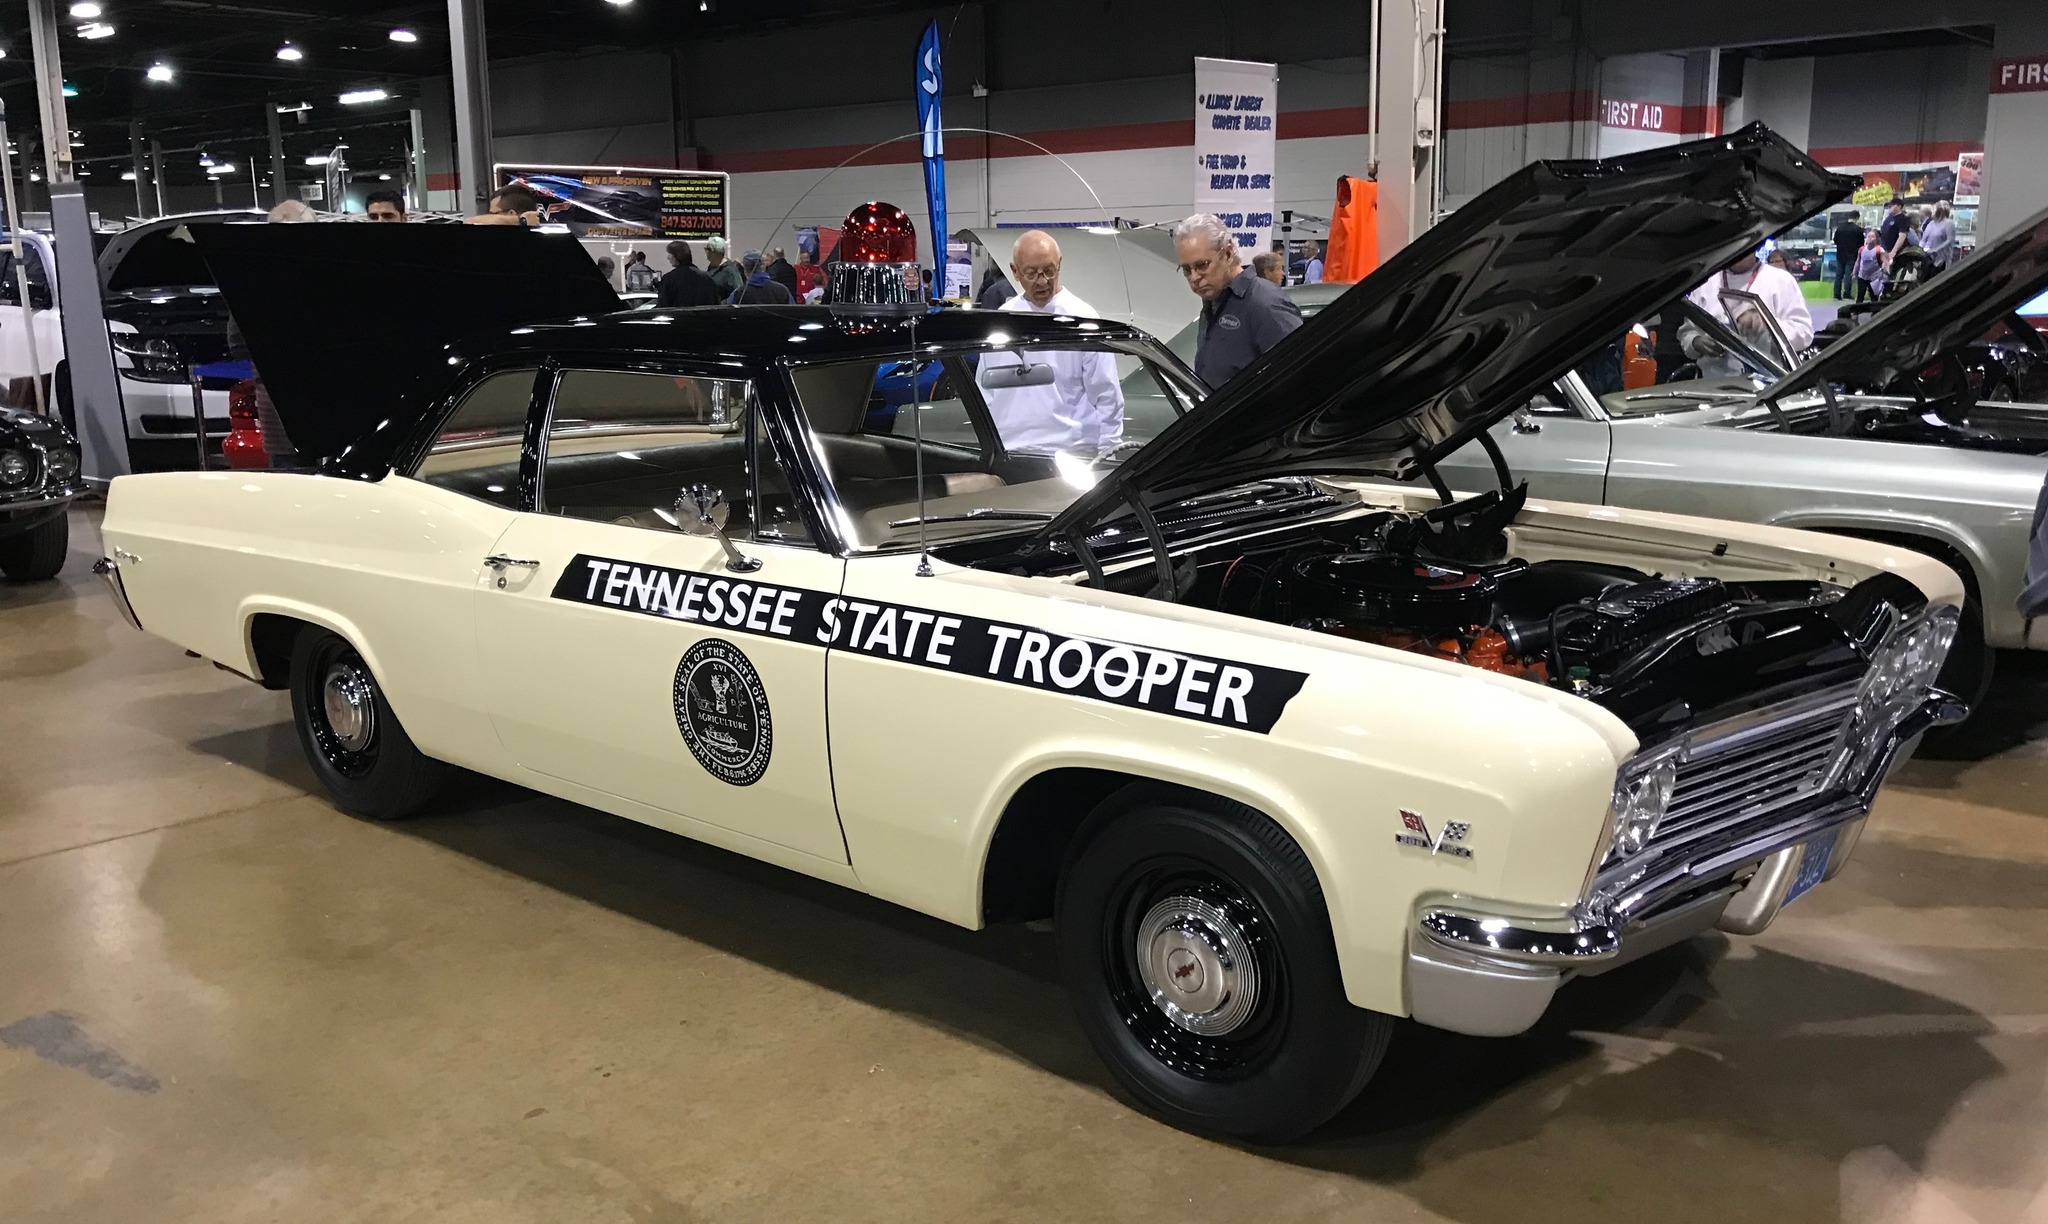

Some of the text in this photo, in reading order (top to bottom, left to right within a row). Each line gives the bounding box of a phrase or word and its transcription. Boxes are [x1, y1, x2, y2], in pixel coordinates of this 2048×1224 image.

[1244, 115, 1271, 130] DEALER
[1641, 105, 1662, 128] AID
[1206, 154, 1219, 169] FREE
[1236, 174, 1249, 189] FOR
[661, 215, 723, 229] 847.537.7000
[586, 560, 1254, 723] TENNESSEE STATE TROOPER
[712, 663, 728, 673] XVI
[678, 647, 768, 775] THE GREAT SEAL OF THE STATE OF TENNESSEE
[697, 712, 749, 731] AGRICULTURE
[706, 744, 746, 763] COMMERCE
